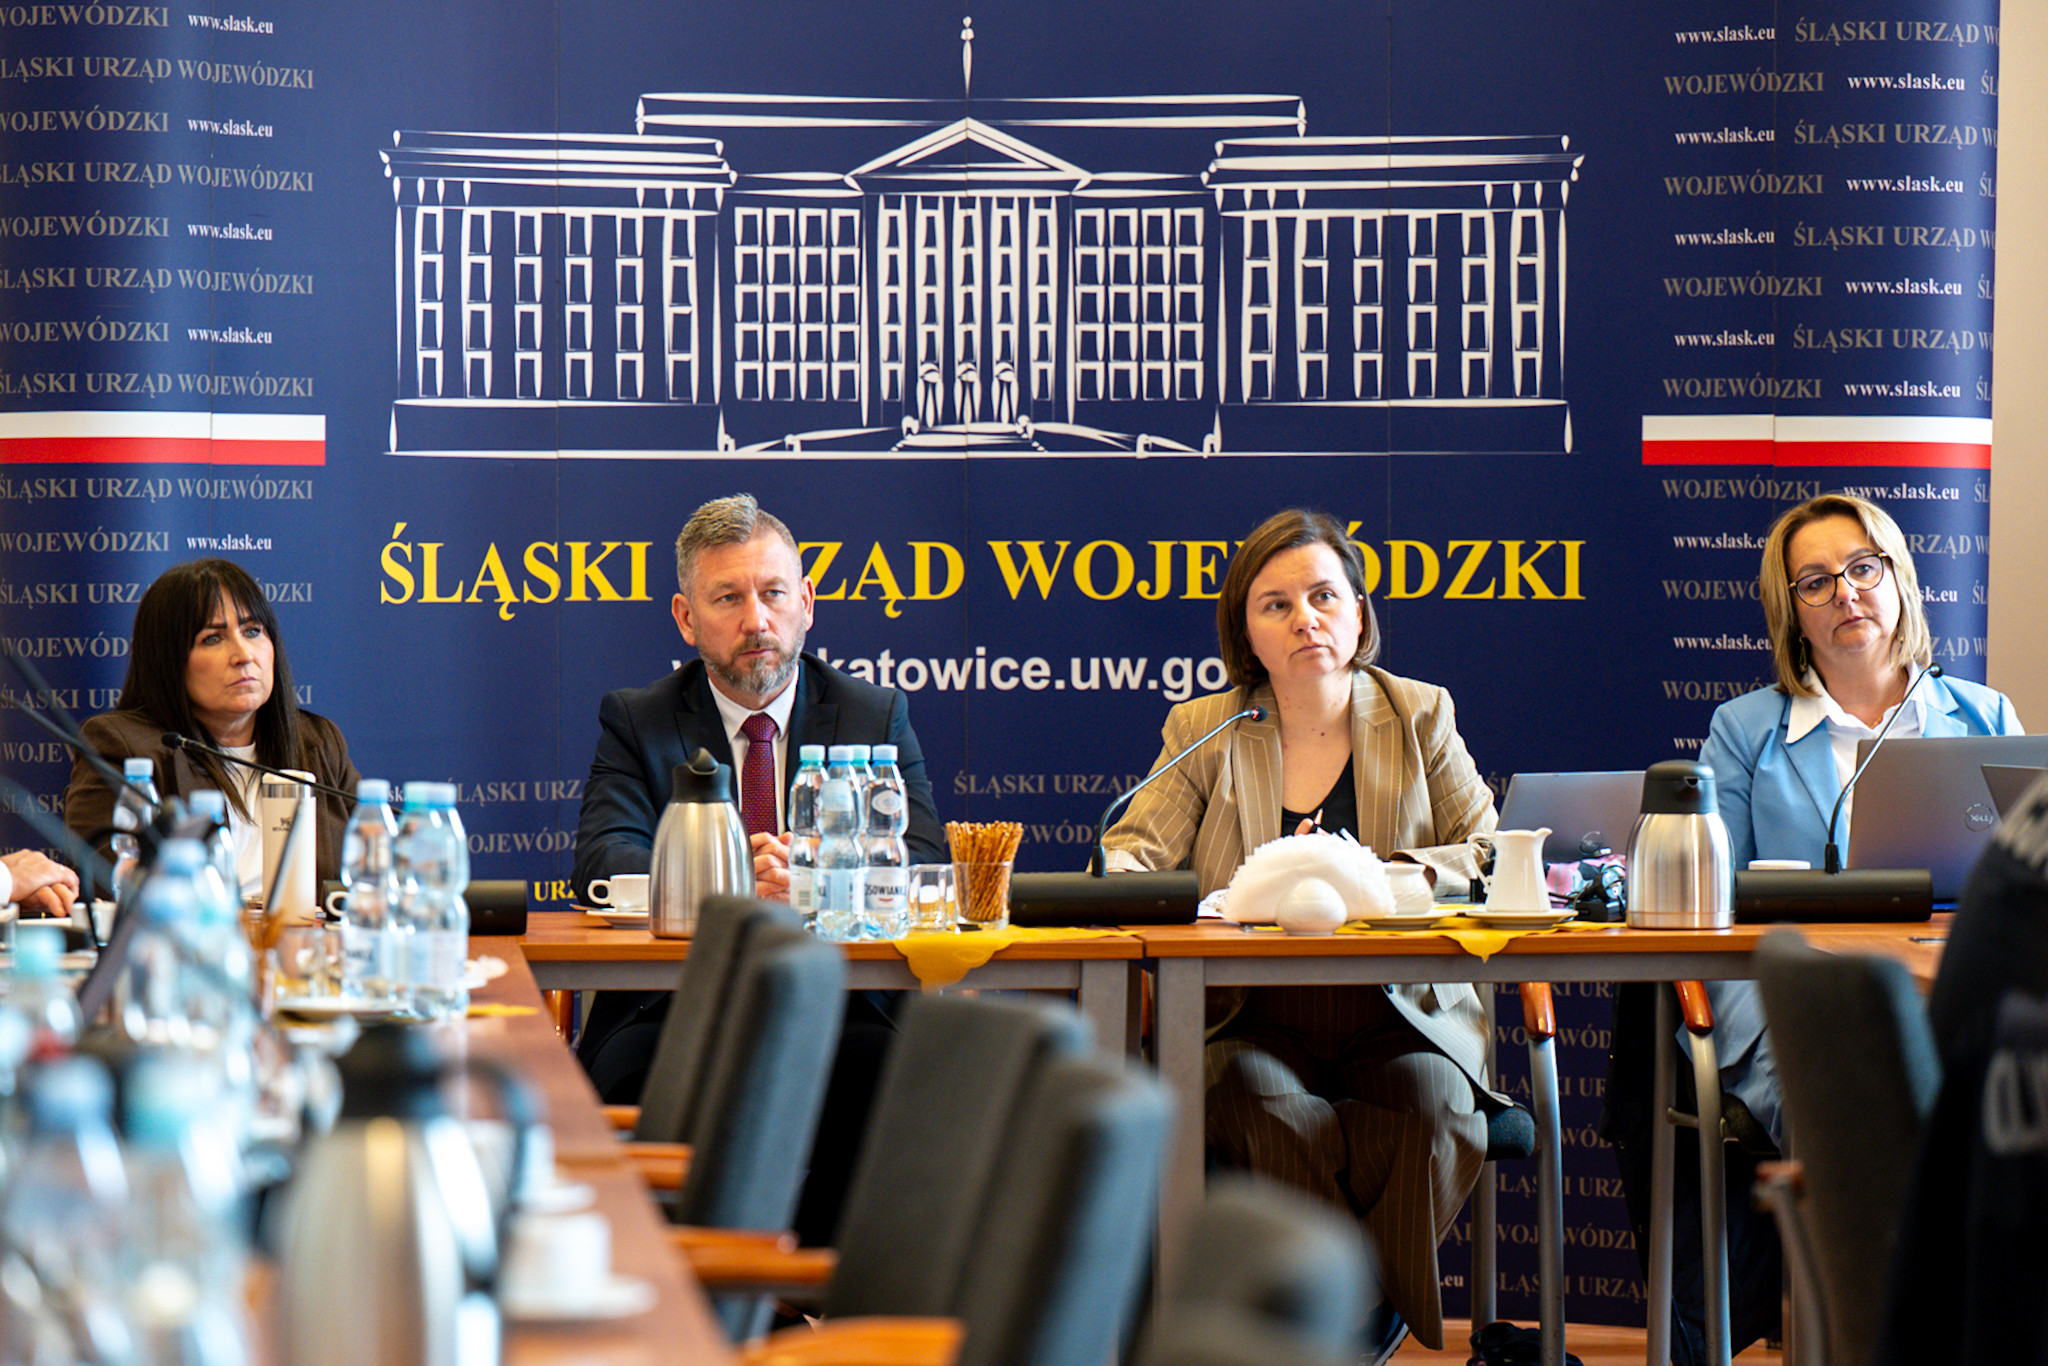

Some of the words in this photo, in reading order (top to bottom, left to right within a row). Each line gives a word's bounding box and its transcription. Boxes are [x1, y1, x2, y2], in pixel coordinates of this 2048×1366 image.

[188, 14, 273, 34] www.slask.eu
[1675, 25, 1776, 44] www.slask.eu
[1794, 17, 1887, 47] ŚLĄSKI
[1896, 21, 1980, 47] URZĄD
[0, 57, 74, 83] LĄSKI
[83, 58, 172, 83] URZĄD
[177, 60, 314, 89] WOJEWÓDZKI
[1664, 67, 1825, 96] WOJEWÓDZKI
[1847, 73, 1965, 91] www.slask.eu
[188, 119, 273, 137] www.slask.eu
[1675, 127, 1775, 145] www.slask.eu
[1794, 119, 1886, 149] ŚLĄSKI
[1895, 124, 1978, 150] URZĄD
[0, 162, 75, 189] LĄSKI
[84, 163, 172, 189] URZĄD
[177, 164, 314, 191] WOJEWÓDZKI
[1664, 169, 1824, 197] WOJEWÓDZKI
[1846, 175, 1964, 193] www.slask.eu
[187, 223, 273, 241] www.slask.eu
[1674, 228, 1775, 246] www.slask.eu
[1793, 221, 1885, 251] ŚLĄSKI
[1893, 226, 1976, 253] URZĄD
[85, 267, 172, 293] URZĄD
[177, 268, 314, 294] WOJEWÓDZKI
[1663, 270, 1823, 297] WOJEWÓDZKI
[1845, 277, 1963, 295] www.slask.eu
[0, 315, 169, 343] WOJEWÓDZKI
[187, 327, 273, 344] www.slask.eu
[1674, 329, 1775, 347] www.slask.eu
[1793, 324, 1884, 354] ŚLĄSKI
[1892, 328, 1975, 355] URZĄD
[86, 372, 172, 399] URZĄD
[177, 371, 314, 397] WOJEWÓDZKI
[1662, 372, 1822, 399] WOJEWÓDZKI
[1844, 379, 1961, 398] www.slask.eu
[0, 474, 78, 504] ŚLĄSKI
[87, 477, 173, 503] URZĄD
[177, 474, 314, 500] WOJEWÓDZKI
[1661, 474, 1821, 500] WOJEWÓDZKI
[0, 526, 169, 552] WOJEWÓDZKI
[186, 533, 272, 550] www.slask.eu
[1902, 533, 1971, 560] RZĄD
[380, 522, 653, 621] ŚLĄSKI
[798, 540, 965, 619] ZĄD
[0, 578, 78, 609] ŚLĄSKI
[2, 632, 129, 658] WOJEWÓD
[449, 777, 526, 807] LĄSKI
[534, 780, 583, 801] URZ
[954, 770, 1045, 798] ŚLĄSKI
